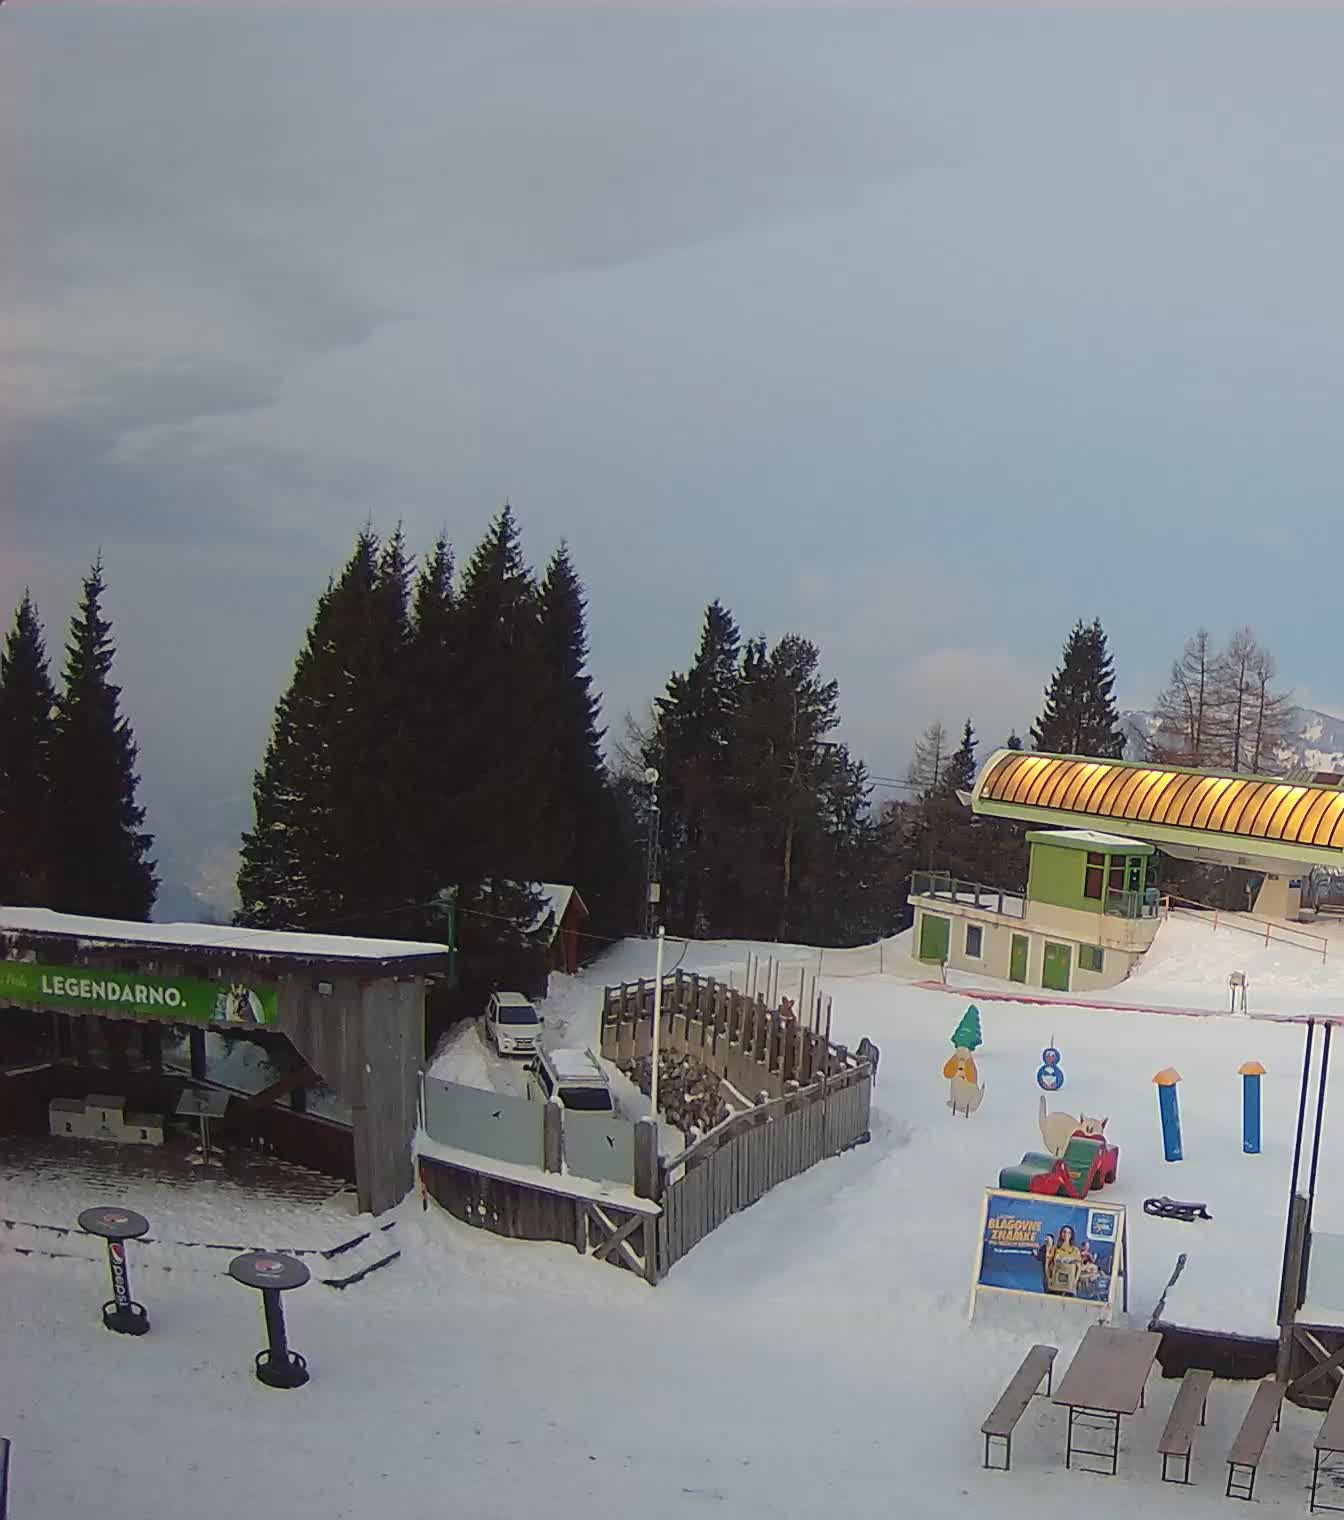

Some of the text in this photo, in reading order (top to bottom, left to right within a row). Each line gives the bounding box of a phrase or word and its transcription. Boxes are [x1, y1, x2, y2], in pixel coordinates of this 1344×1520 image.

[42, 975, 187, 1007] LEGENDARNO.
[65, 1122, 73, 1133] 2
[140, 1129, 147, 1140] 3
